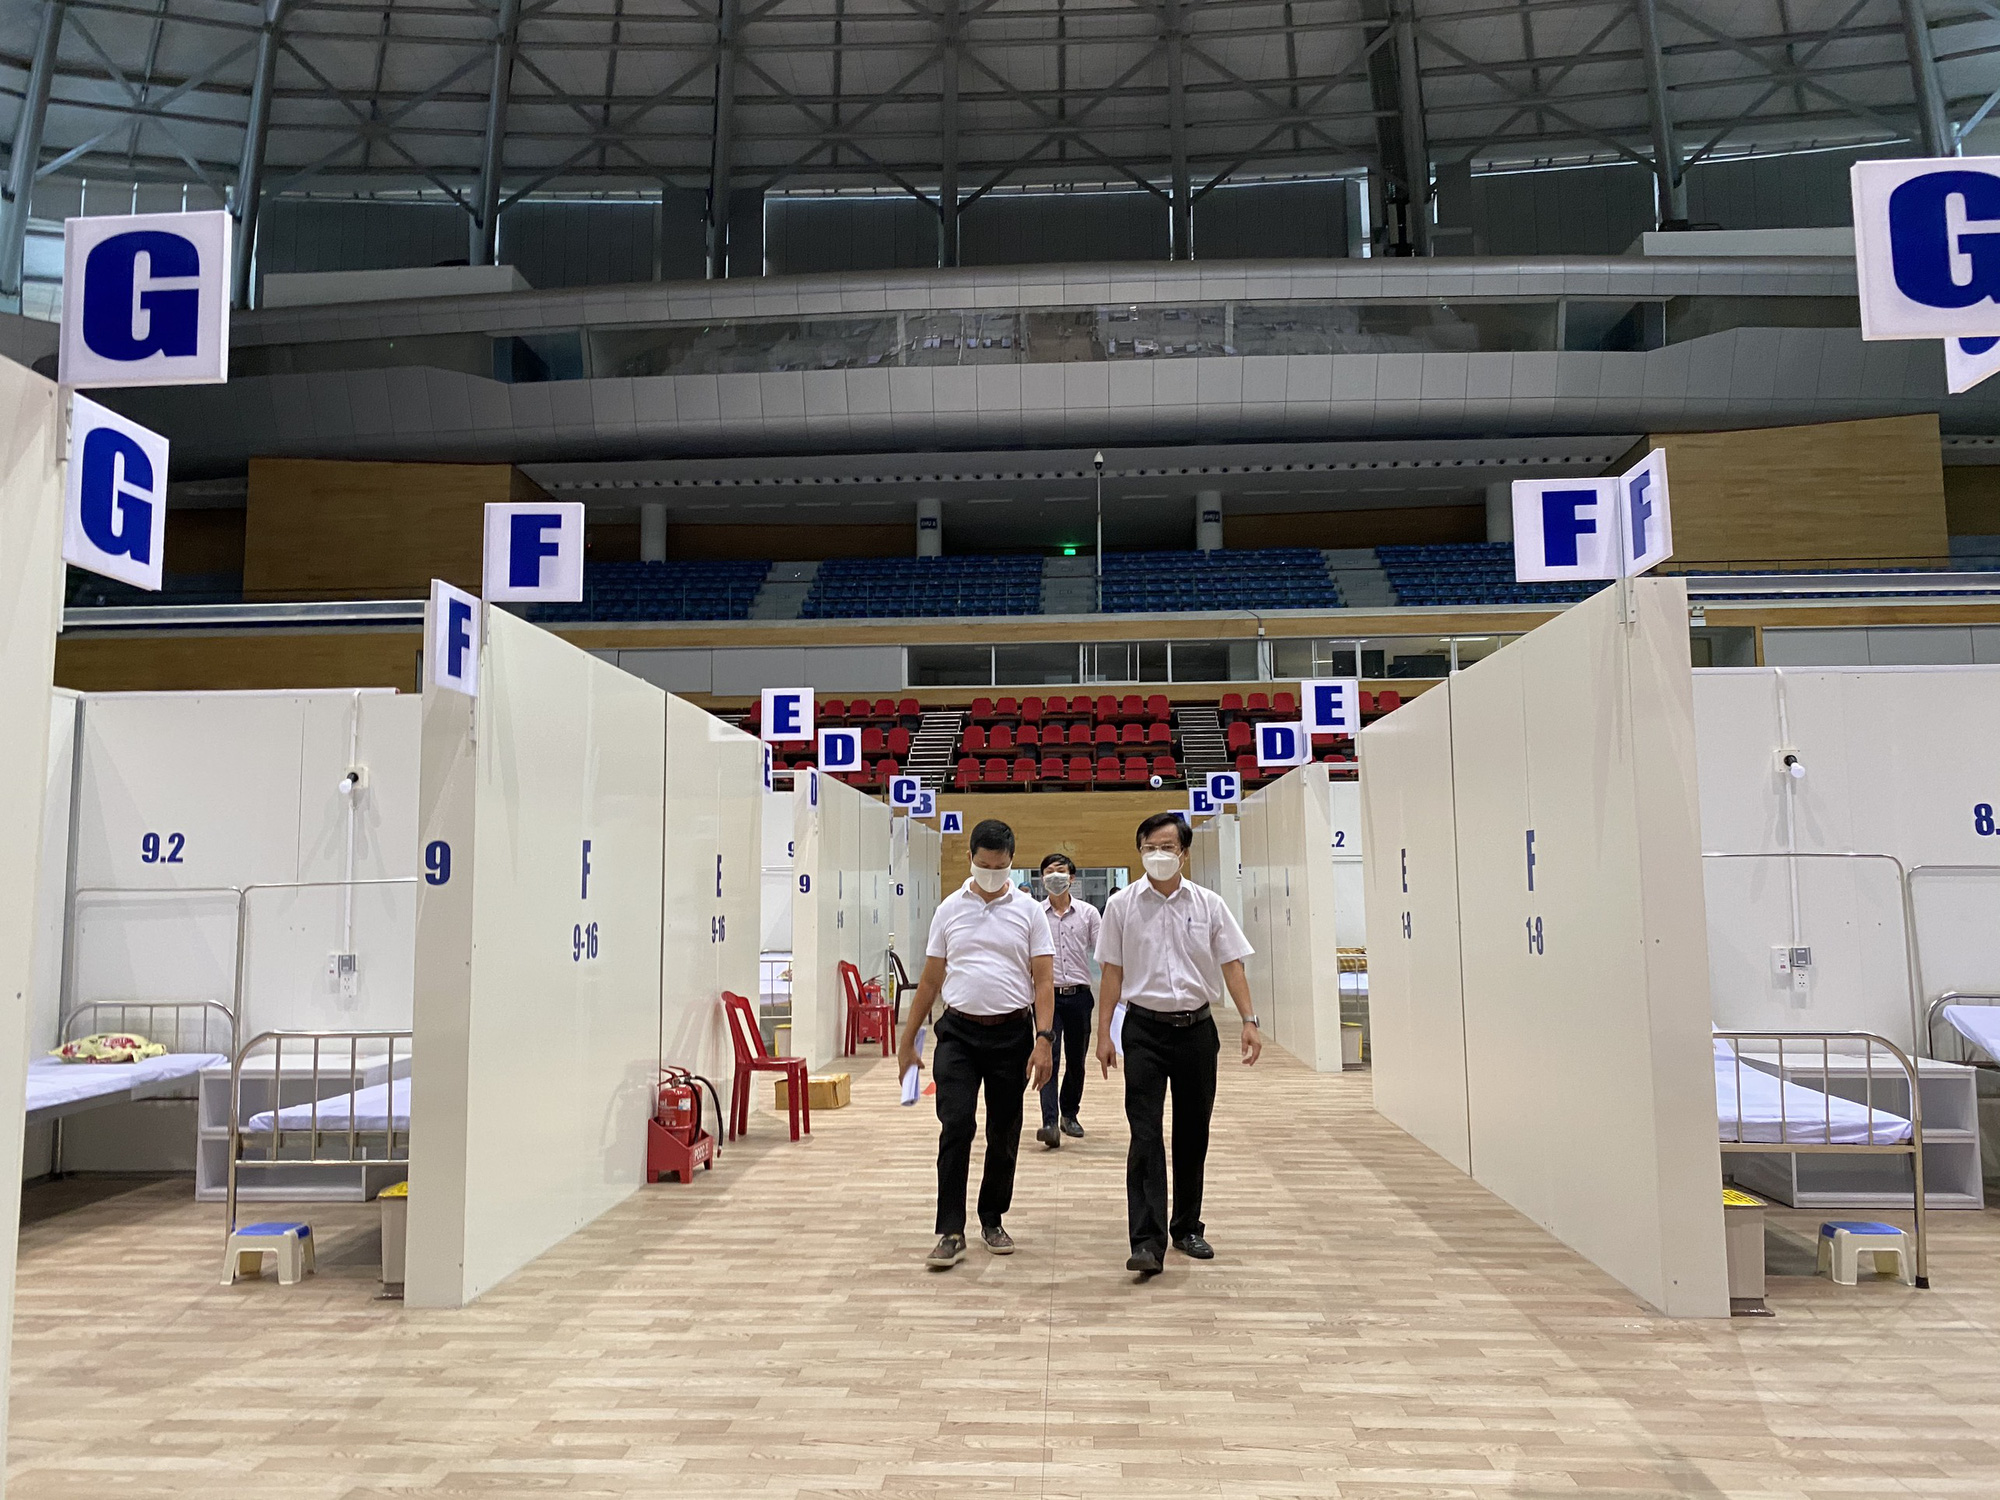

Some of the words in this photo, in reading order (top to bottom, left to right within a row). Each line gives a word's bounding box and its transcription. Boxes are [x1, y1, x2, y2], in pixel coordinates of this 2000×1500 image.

[1889, 171, 2000, 308] G
[83, 230, 200, 361] G
[81, 428, 153, 565] G
[1630, 470, 1651, 559] F
[1542, 490, 1597, 566] F
[509, 514, 562, 587] F
[448, 598, 471, 678] F
[773, 695, 801, 734] E
[1315, 686, 1345, 726] E
[825, 734, 854, 765] D
[1262, 728, 1295, 760] D
[764, 748, 771, 788] E
[1211, 775, 1234, 799] C
[811, 772, 818, 805] D
[894, 780, 916, 803] C
[911, 792, 932, 814] B
[1193, 790, 1214, 811] B
[943, 814, 960, 830] A
[142, 833, 185, 863] 9.2
[425, 840, 451, 885] 9
[1526, 830, 1535, 891] F
[582, 840, 591, 899] F
[717, 854, 722, 897] E
[799, 874, 810, 893] 9
[1401, 849, 1407, 893] E
[896, 883, 903, 896] 6
[573, 922, 598, 962] 9-16
[712, 915, 725, 943] 9-16
[1402, 911, 1411, 939] 1-8
[1526, 917, 1543, 955] 1-8
